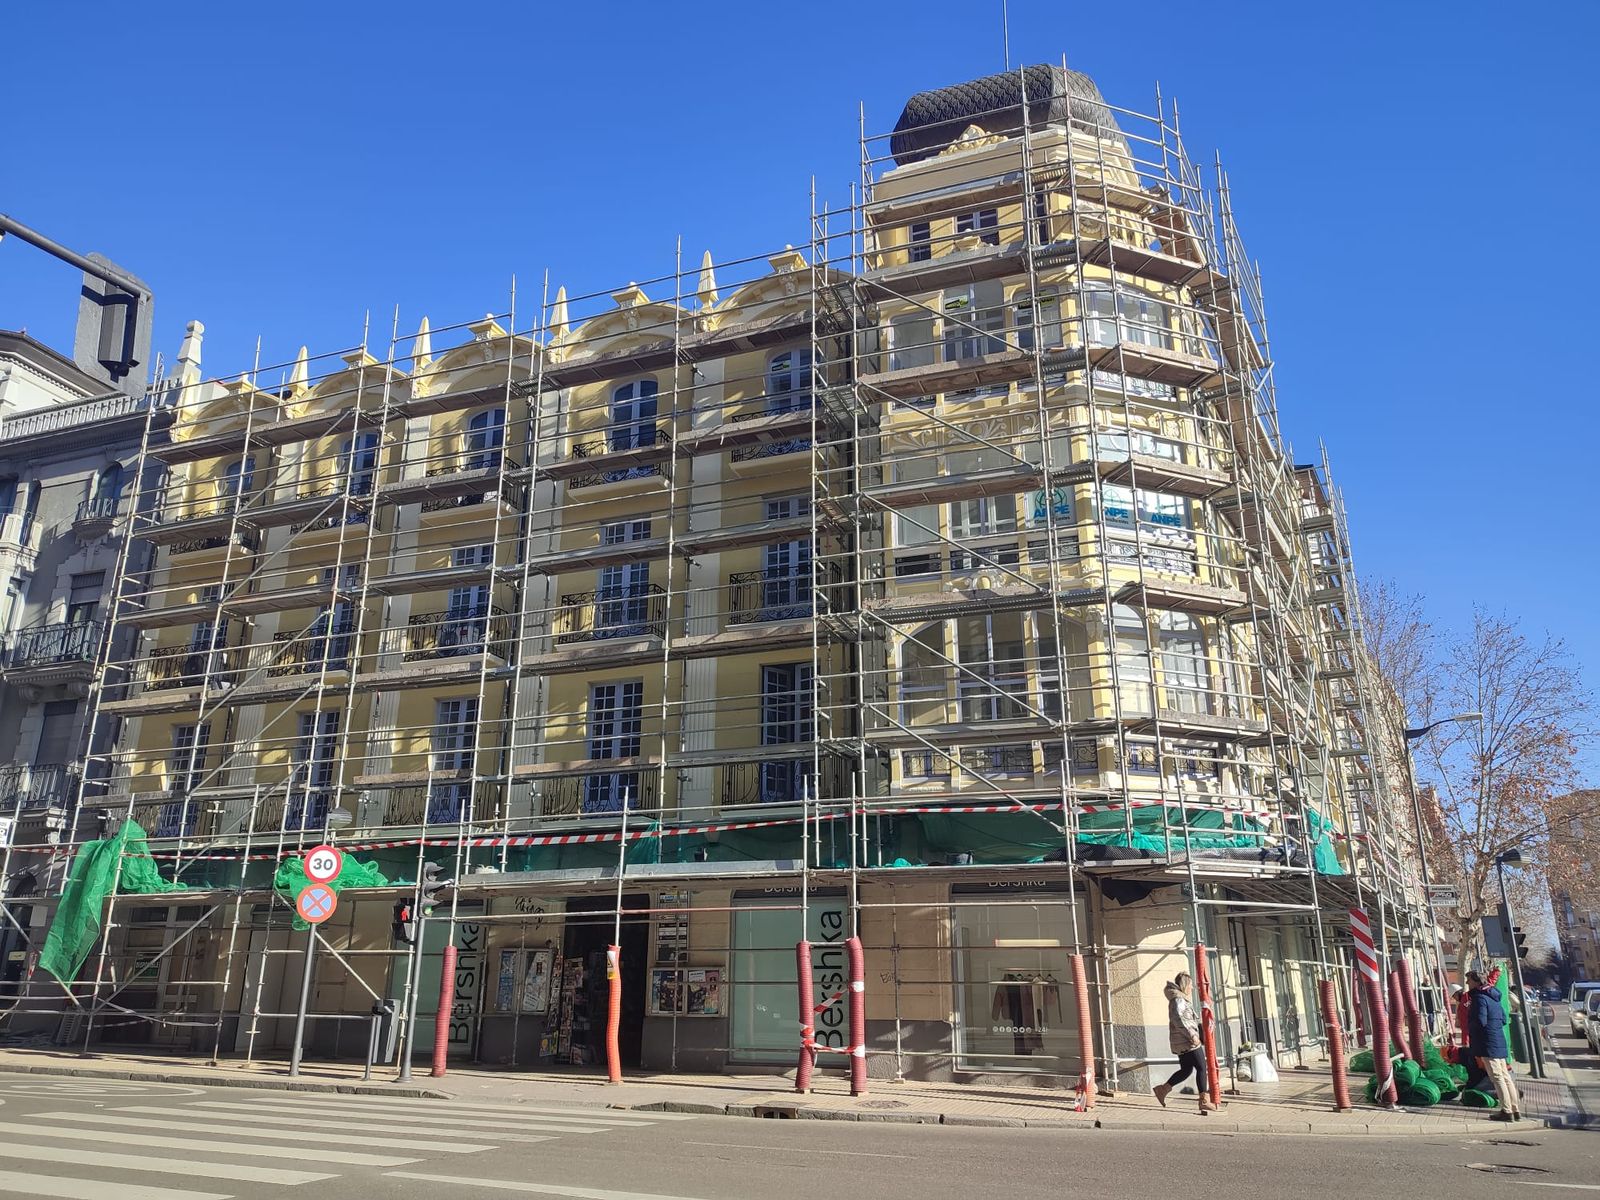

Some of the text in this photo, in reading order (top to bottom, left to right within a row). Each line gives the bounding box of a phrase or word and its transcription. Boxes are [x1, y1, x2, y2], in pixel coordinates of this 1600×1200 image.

[1104, 507, 1128, 518] NPE
[1151, 513, 1181, 527] ANPE
[313, 858, 333, 870] 30
[813, 910, 843, 1047] Bershka
